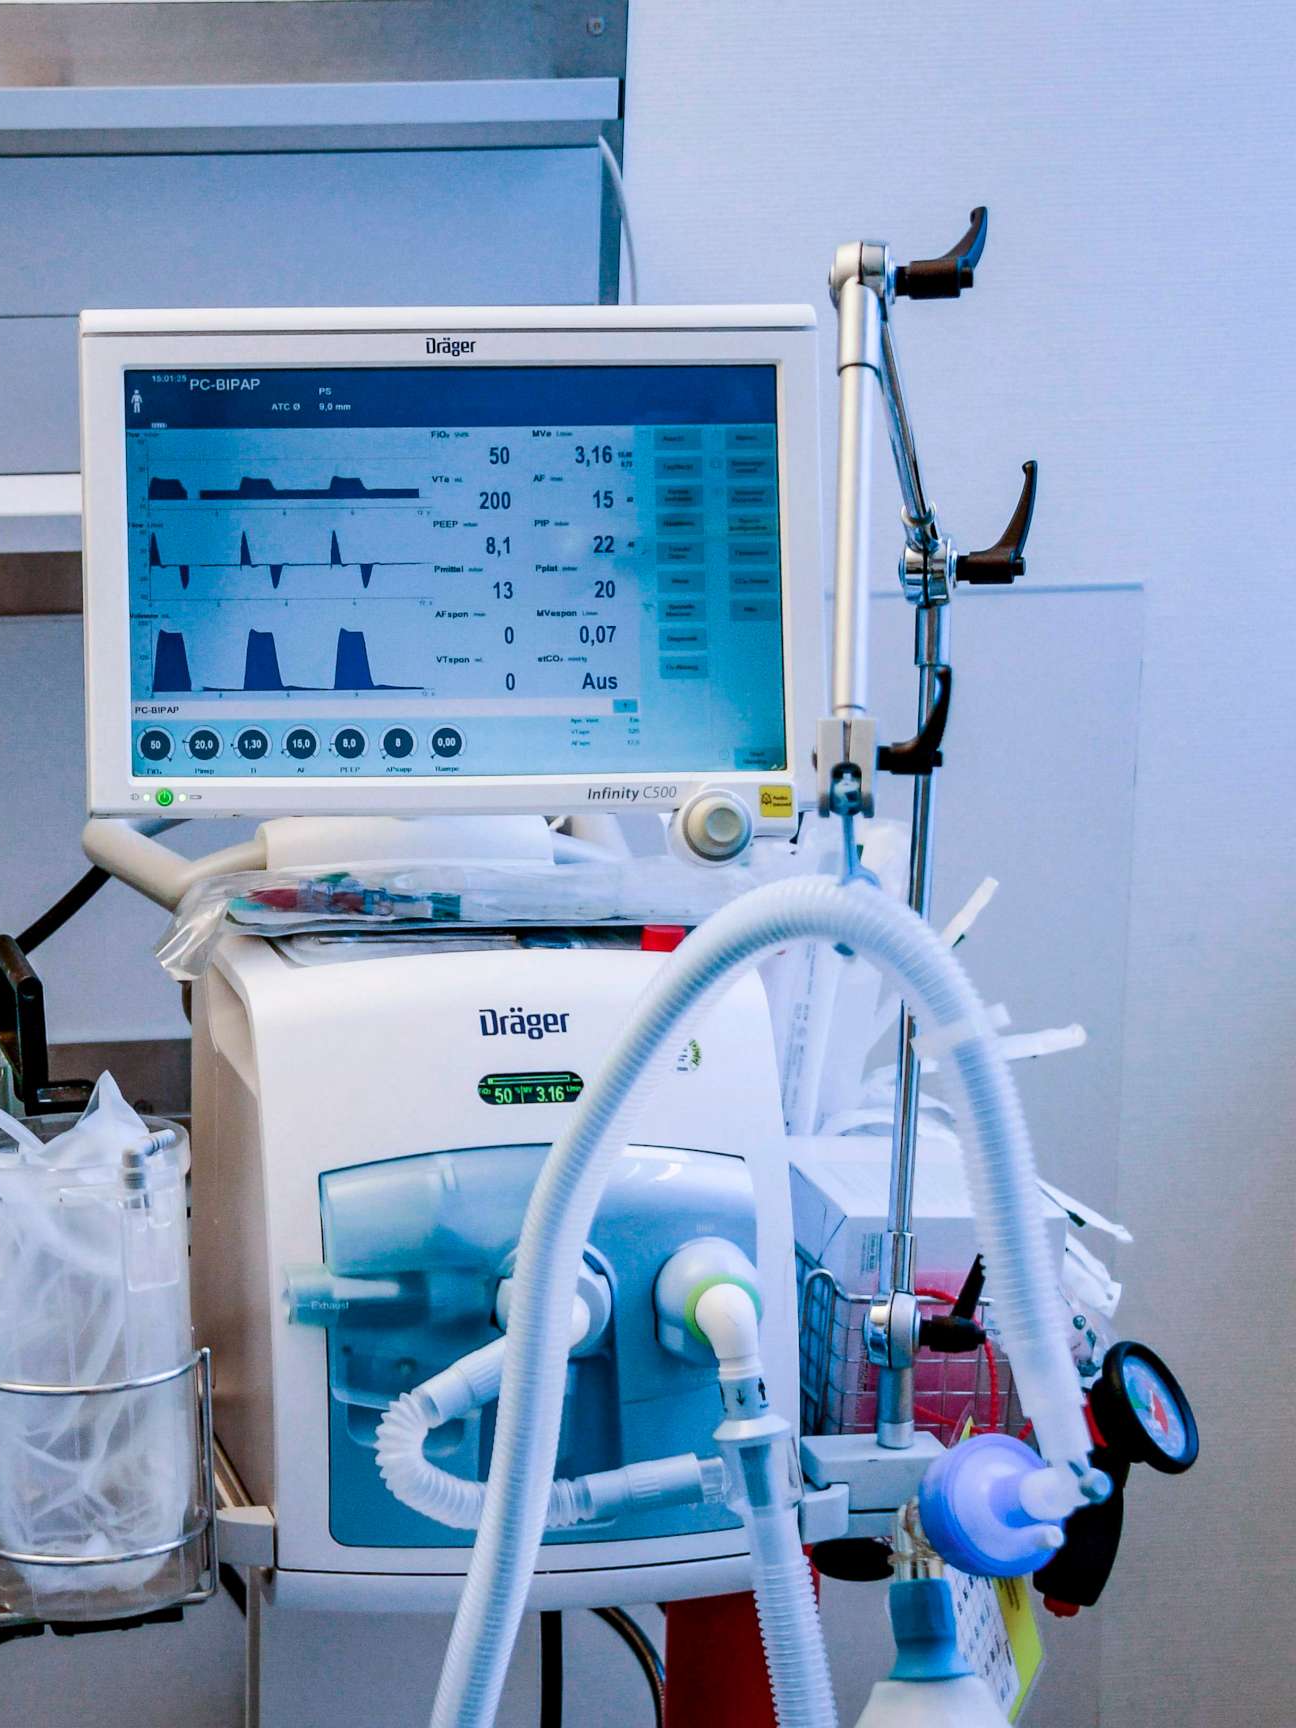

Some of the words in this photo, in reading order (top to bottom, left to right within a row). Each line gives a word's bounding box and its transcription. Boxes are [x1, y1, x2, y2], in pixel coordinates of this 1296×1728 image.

[426, 337, 476, 357] Dräger
[190, 378, 260, 391] PC-BIPAP
[319, 387, 332, 396] PS
[271, 402, 291, 411] ATC
[319, 402, 334, 412] 9,0
[334, 403, 351, 411] mm
[489, 446, 510, 465] 50
[575, 445, 612, 467] 3,16
[533, 474, 545, 483] AF
[479, 491, 511, 510] 200
[592, 490, 614, 509] 15
[433, 520, 458, 528] PEEP
[534, 519, 550, 527] PIP
[486, 536, 511, 557] 8,1
[593, 535, 615, 554] 22
[535, 564, 558, 573] Pplat
[493, 581, 513, 600] 13
[594, 580, 616, 599] 20
[504, 626, 514, 645] 0
[579, 625, 617, 646] 0,07
[436, 656, 470, 665] VTspon
[505, 672, 516, 691] 0
[581, 672, 618, 690] Aus
[134, 705, 180, 715] PC-BIPAP
[194, 740, 213, 749] 20,0
[437, 737, 456, 748] 0,00
[587, 787, 639, 802] Infinity
[642, 785, 677, 799] C500
[478, 1006, 570, 1040] Dräger
[495, 1087, 513, 1104] 50
[536, 1085, 565, 1102] 3.16
